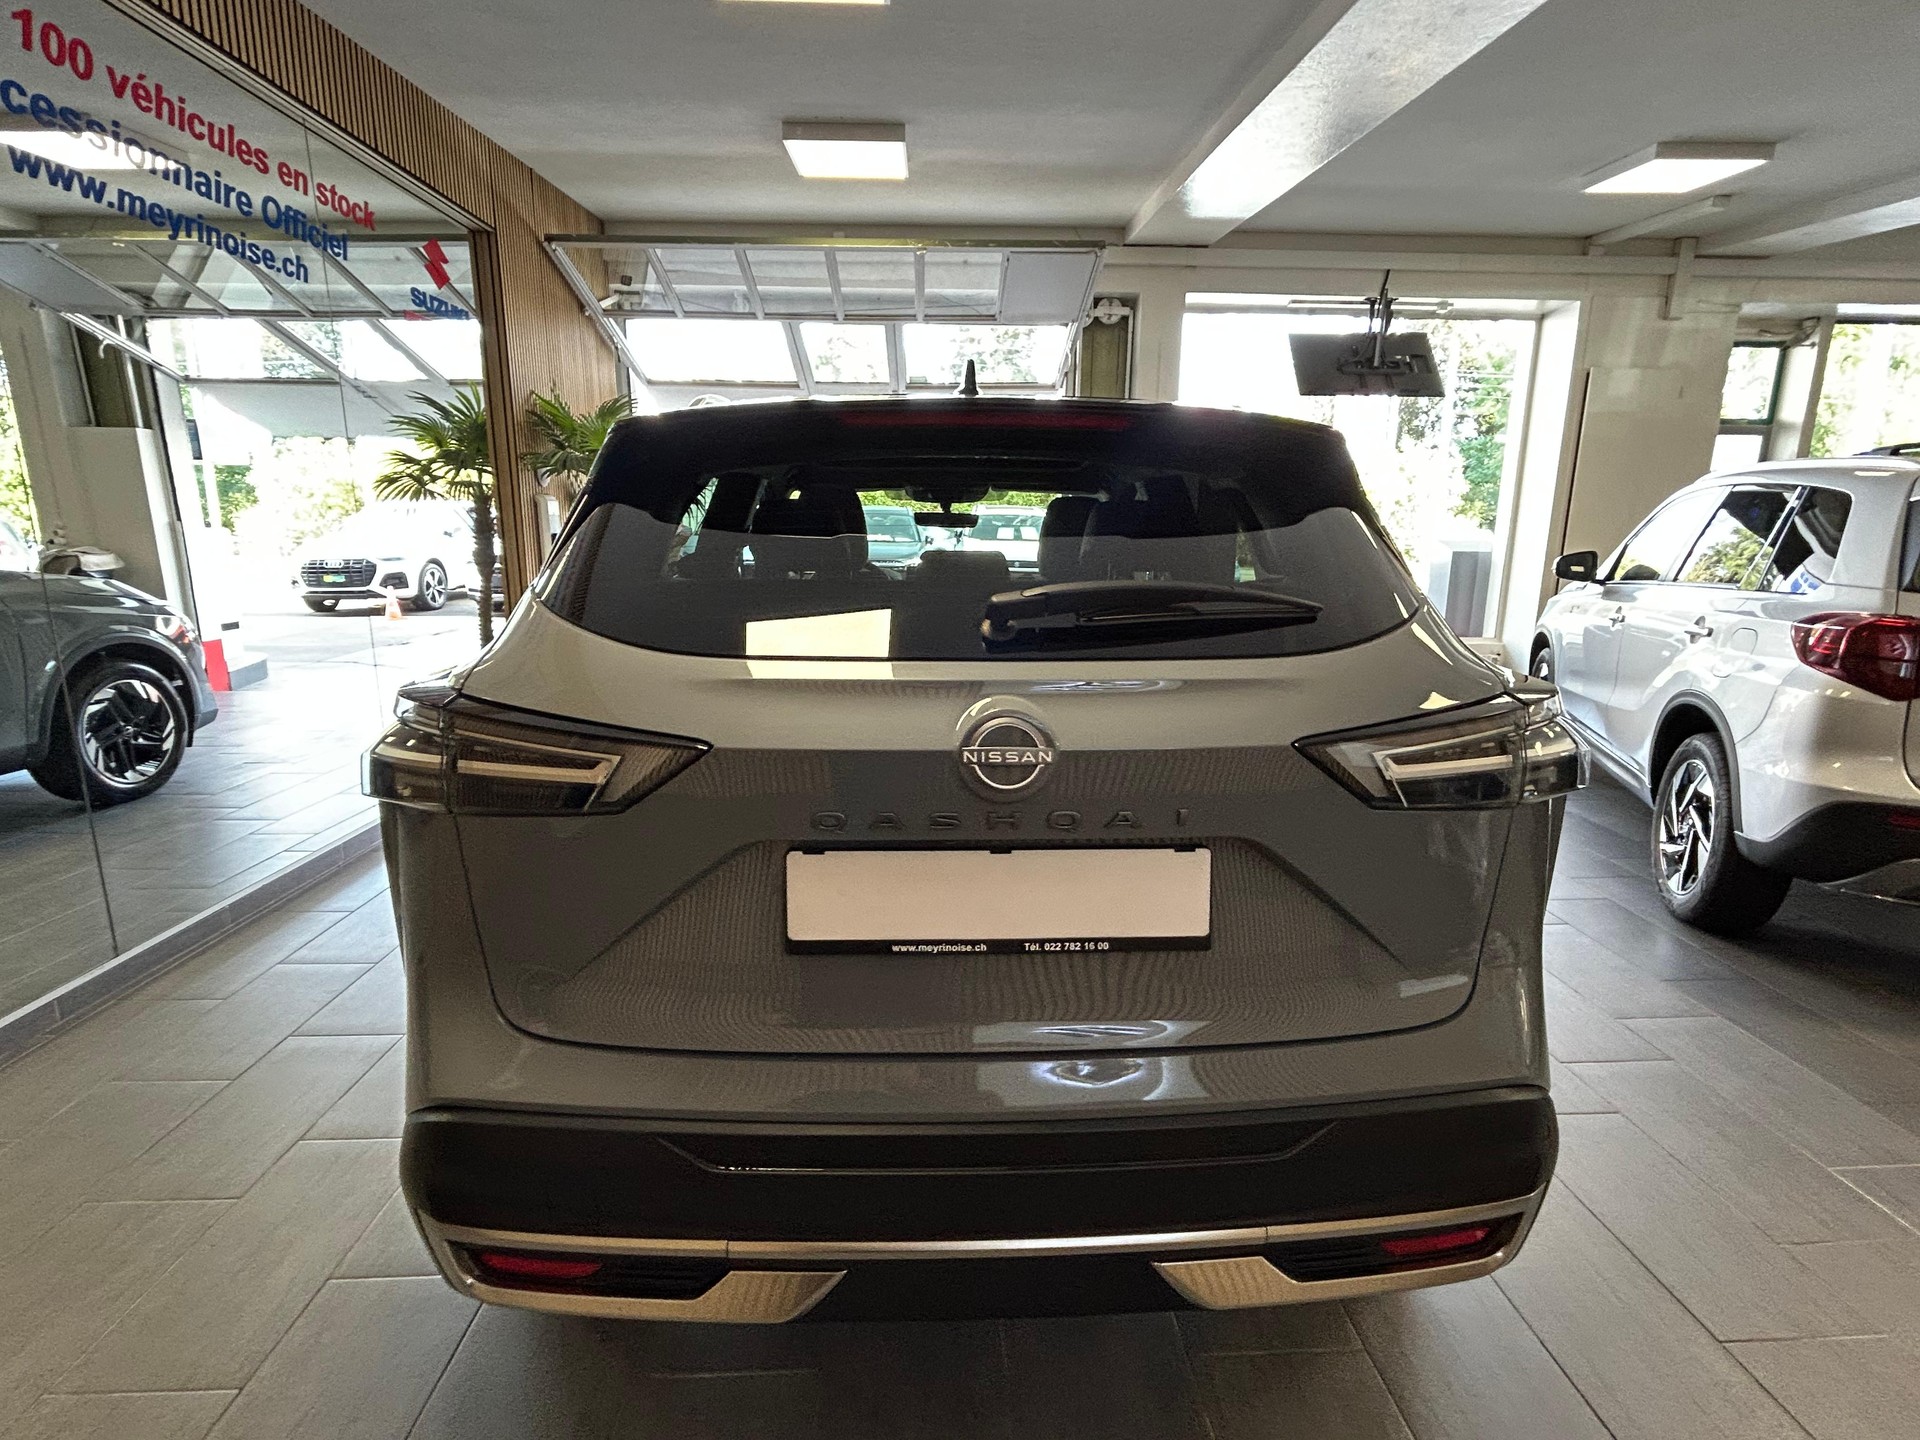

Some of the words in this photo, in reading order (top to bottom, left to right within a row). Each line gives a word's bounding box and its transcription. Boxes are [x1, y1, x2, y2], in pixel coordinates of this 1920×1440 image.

[11, 9, 94, 81] 100
[106, 65, 270, 175] véhicules
[277, 161, 308, 196] en
[316, 182, 376, 231] stock
[0, 79, 254, 217] cessionnaire
[261, 195, 348, 260] Officiel
[7, 144, 308, 283] www.meyrinoise.ch
[963, 751, 1053, 763] NISSAN
[809, 808, 1192, 834] QASHQAI
[891, 943, 987, 954] www.meyrinoise.ch
[1023, 942, 1042, 951] Tél.
[1043, 942, 1062, 951] 022
[1063, 942, 1081, 951] 782
[1084, 941, 1096, 950] 16
[1097, 941, 1109, 950] 00
